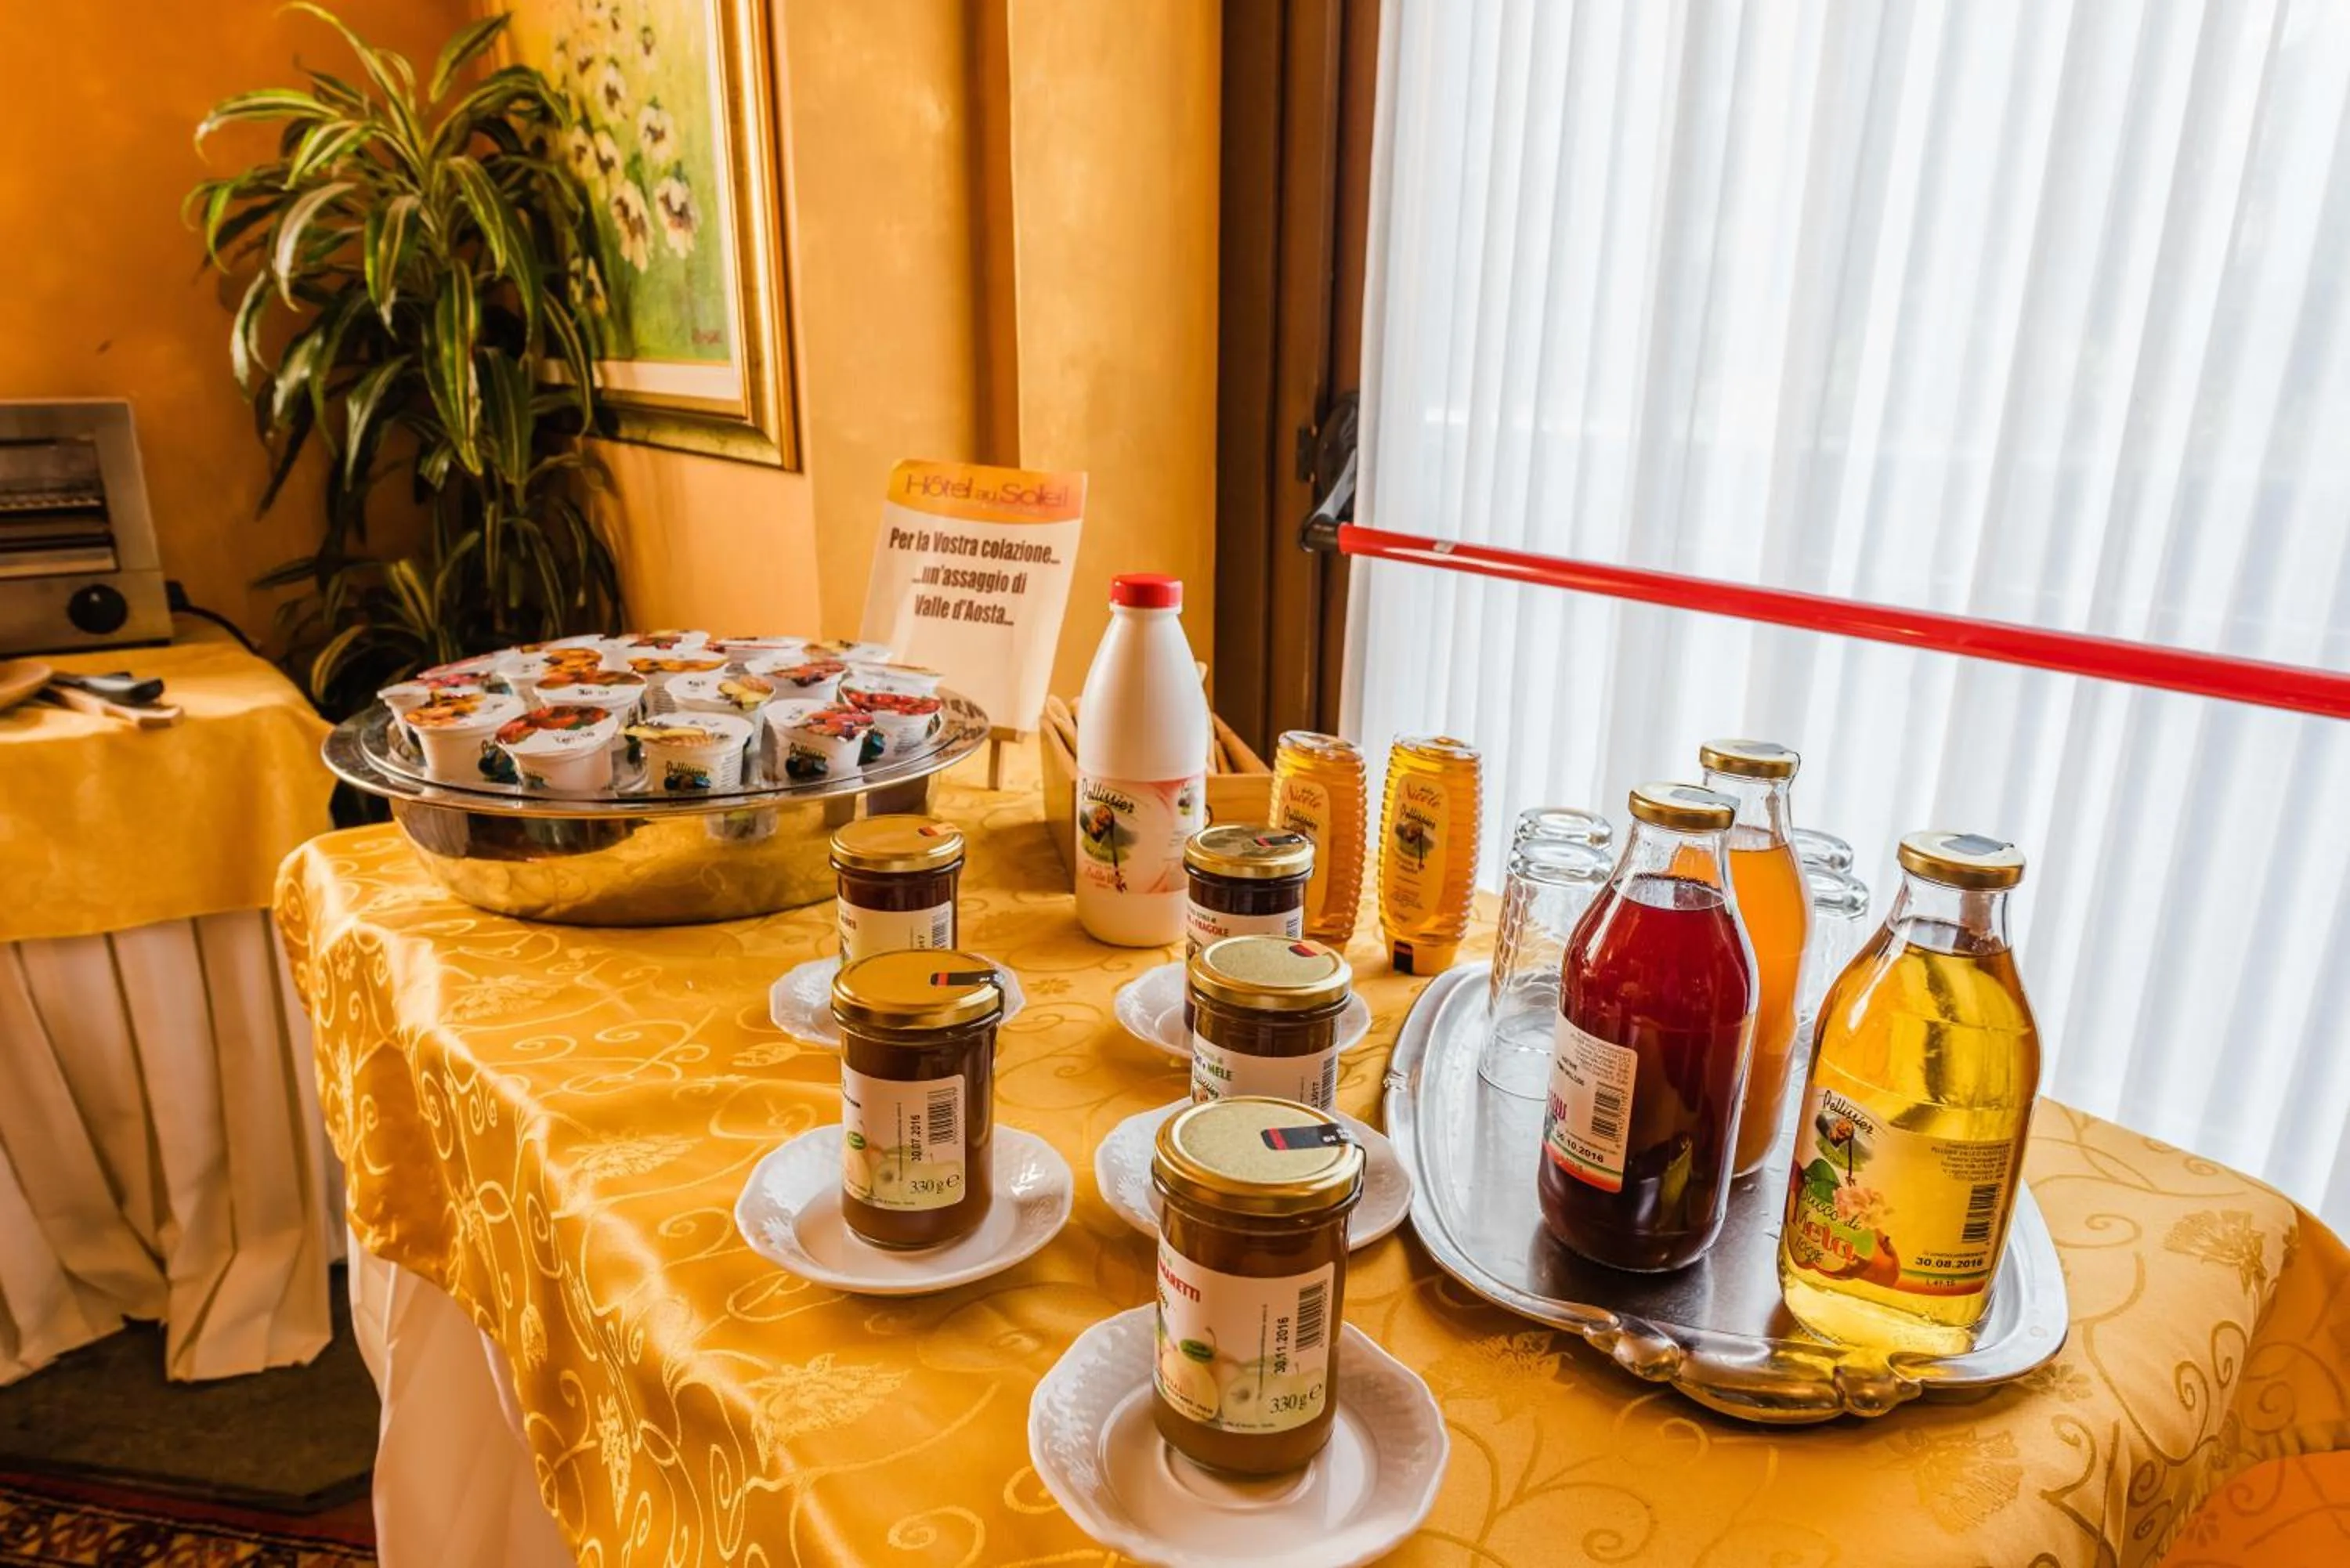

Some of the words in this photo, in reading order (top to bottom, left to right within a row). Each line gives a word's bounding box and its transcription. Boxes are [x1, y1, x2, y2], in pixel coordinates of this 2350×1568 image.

[903, 474, 974, 500] Hôtel
[1000, 482, 1070, 507] Soleil
[889, 527, 914, 550] Per
[916, 530, 931, 552] la
[934, 532, 979, 557] Vostra
[1011, 573, 1029, 594] di
[914, 594, 950, 620] Valle
[1822, 1089, 1874, 1136] Pellissier
[1273, 1317, 1289, 1373] 30.11.2016
